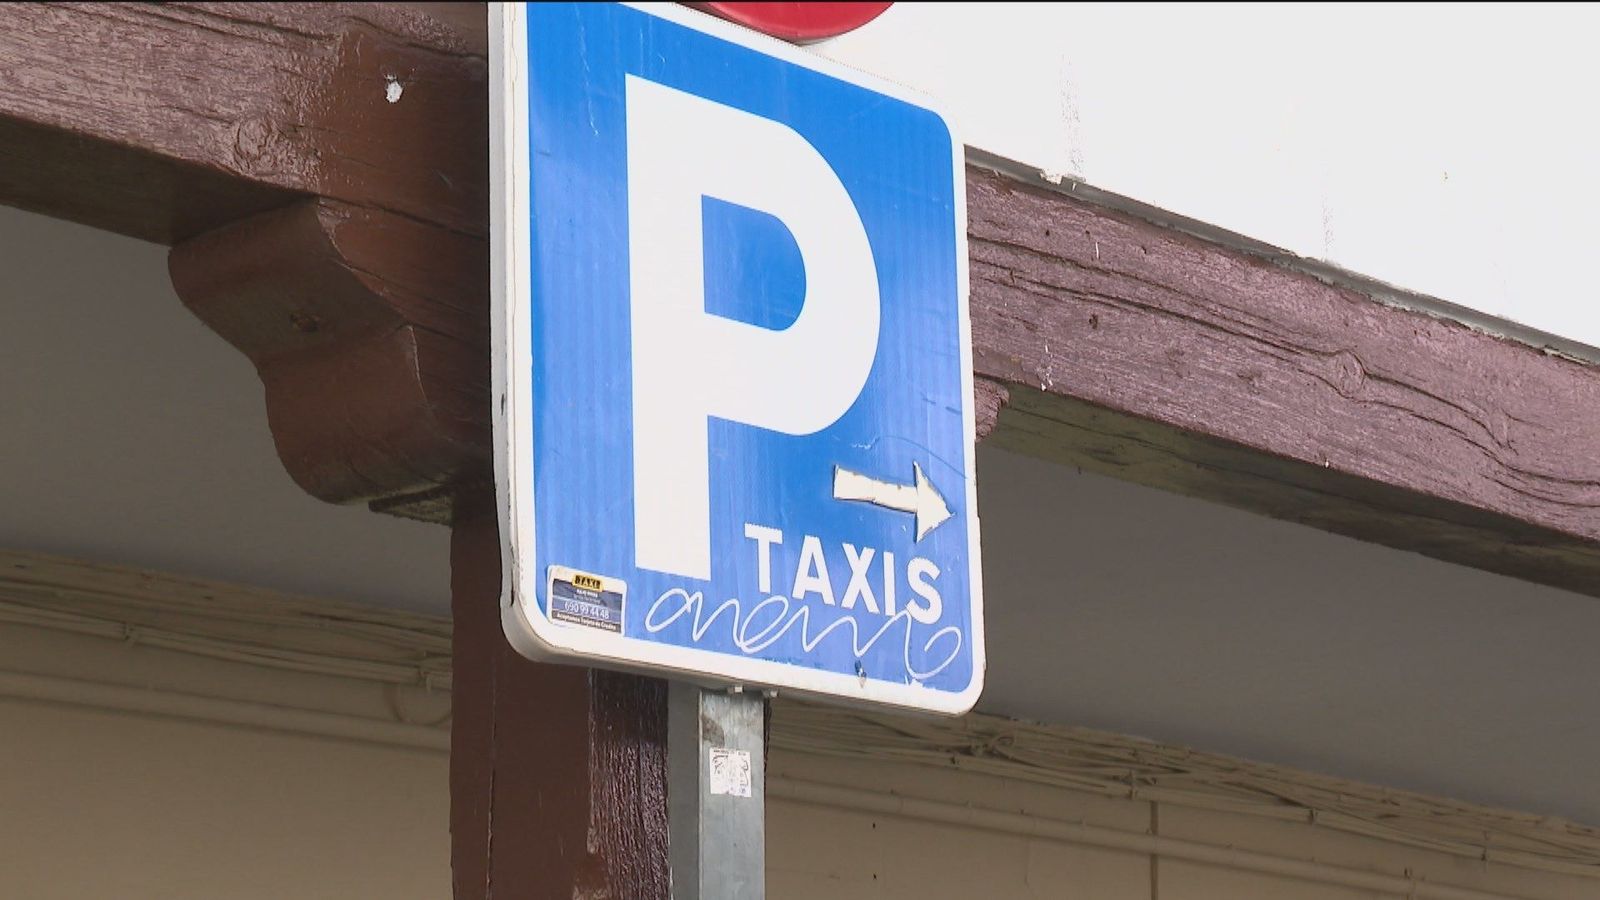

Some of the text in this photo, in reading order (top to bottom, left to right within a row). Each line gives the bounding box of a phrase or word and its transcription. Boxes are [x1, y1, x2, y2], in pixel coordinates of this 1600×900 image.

[624, 73, 880, 581] P
[575, 575, 601, 589] TAXI
[744, 523, 943, 625] TAXIS
